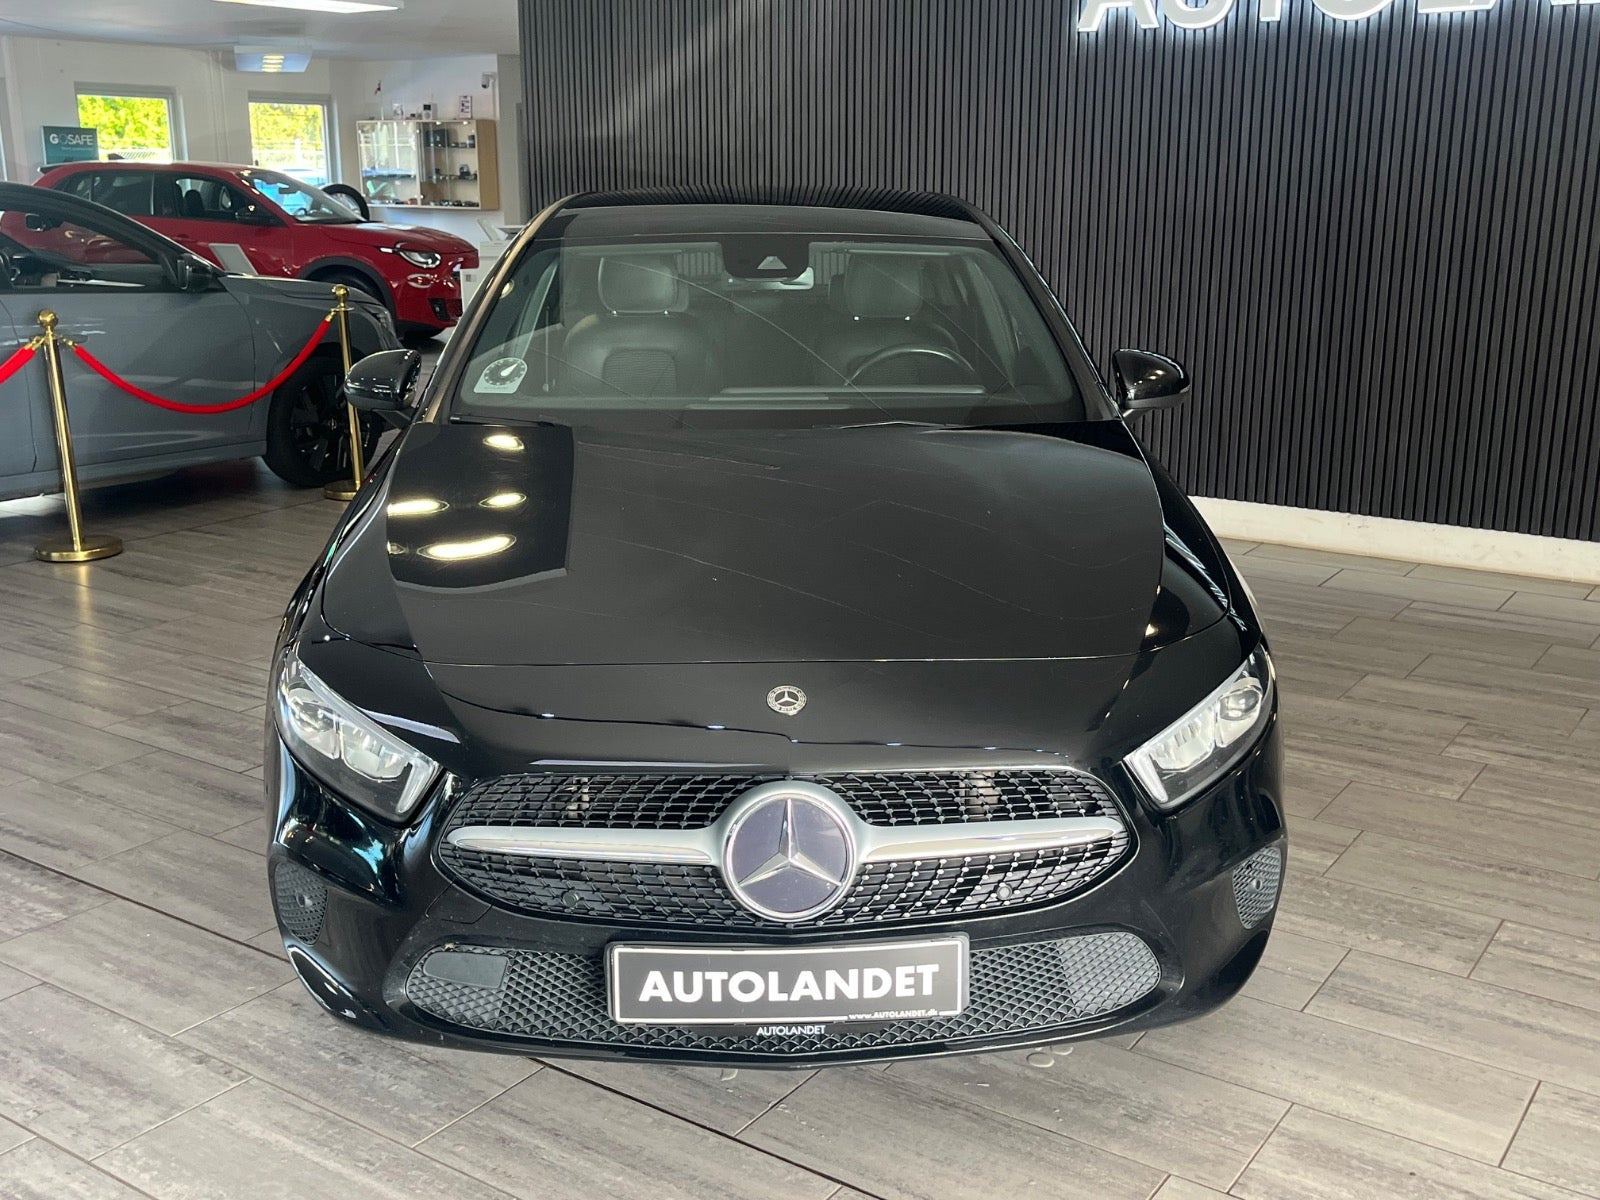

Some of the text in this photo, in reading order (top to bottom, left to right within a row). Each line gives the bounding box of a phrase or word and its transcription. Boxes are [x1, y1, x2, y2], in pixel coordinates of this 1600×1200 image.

[638, 963, 939, 1002] AUTOLANDET
[848, 1008, 938, 1020] www.AUTOLANDET.dk
[756, 1024, 827, 1037] AUTOLANDET
